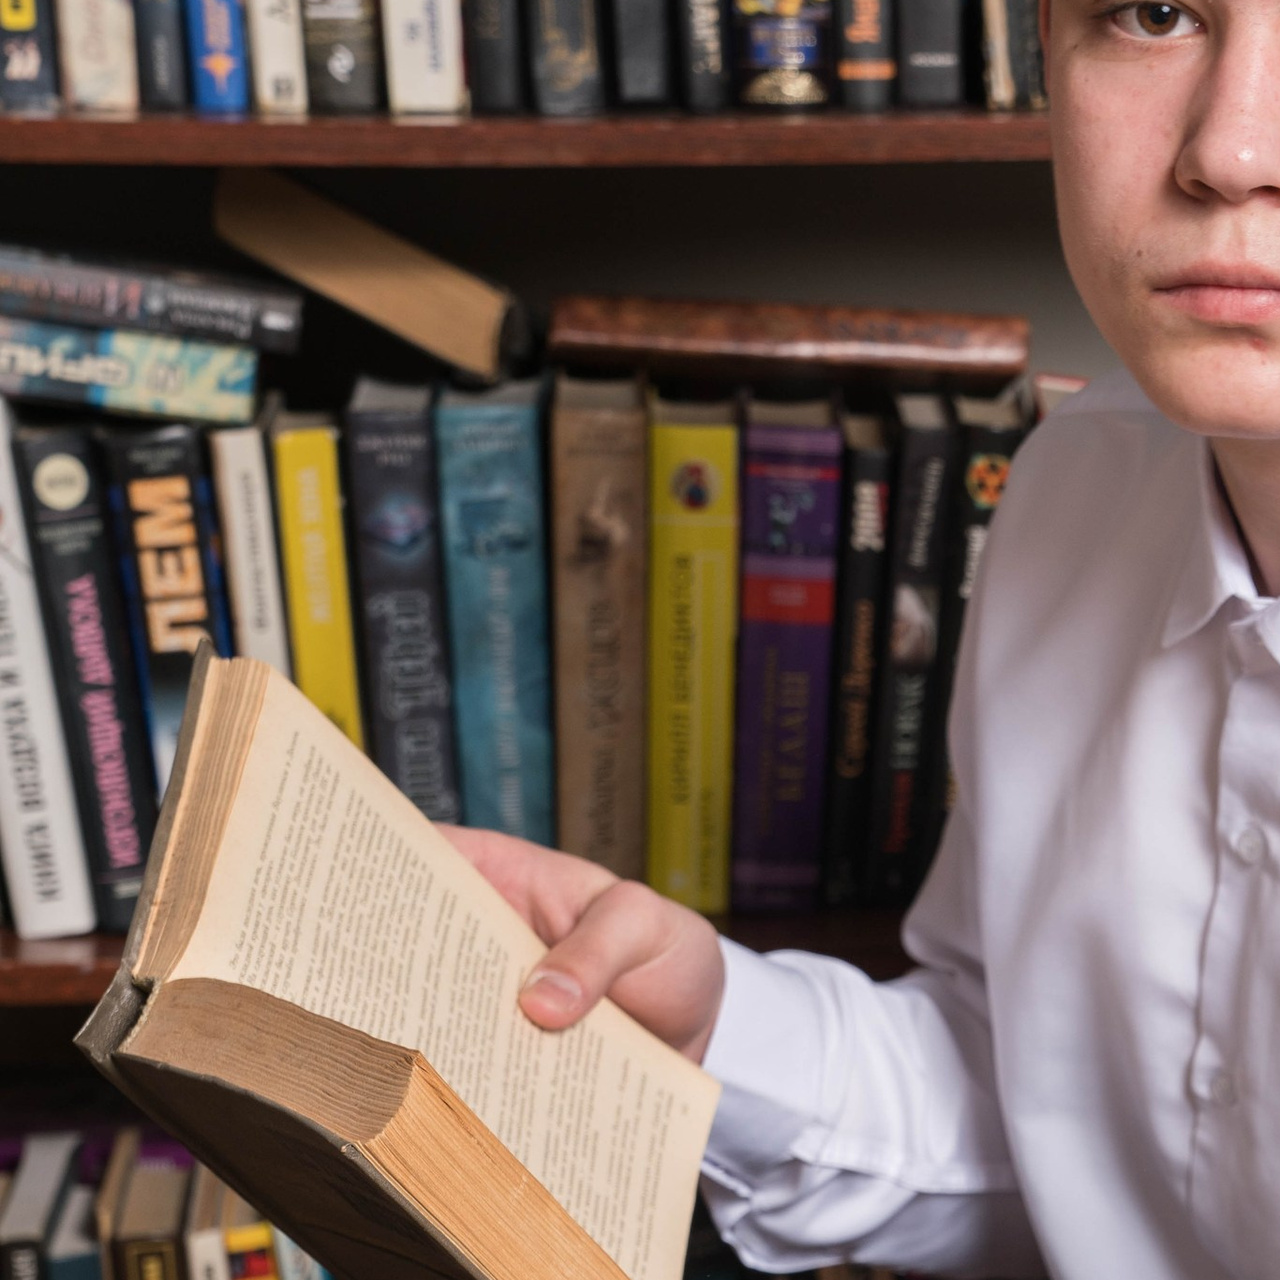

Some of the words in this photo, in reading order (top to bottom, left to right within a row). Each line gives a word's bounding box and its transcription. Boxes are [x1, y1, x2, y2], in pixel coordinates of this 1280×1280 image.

[126, 474, 208, 656] ЛЕМ
[2, 696, 46, 815] ВОЗДУХА
[24, 819, 62, 903] КНИГА
